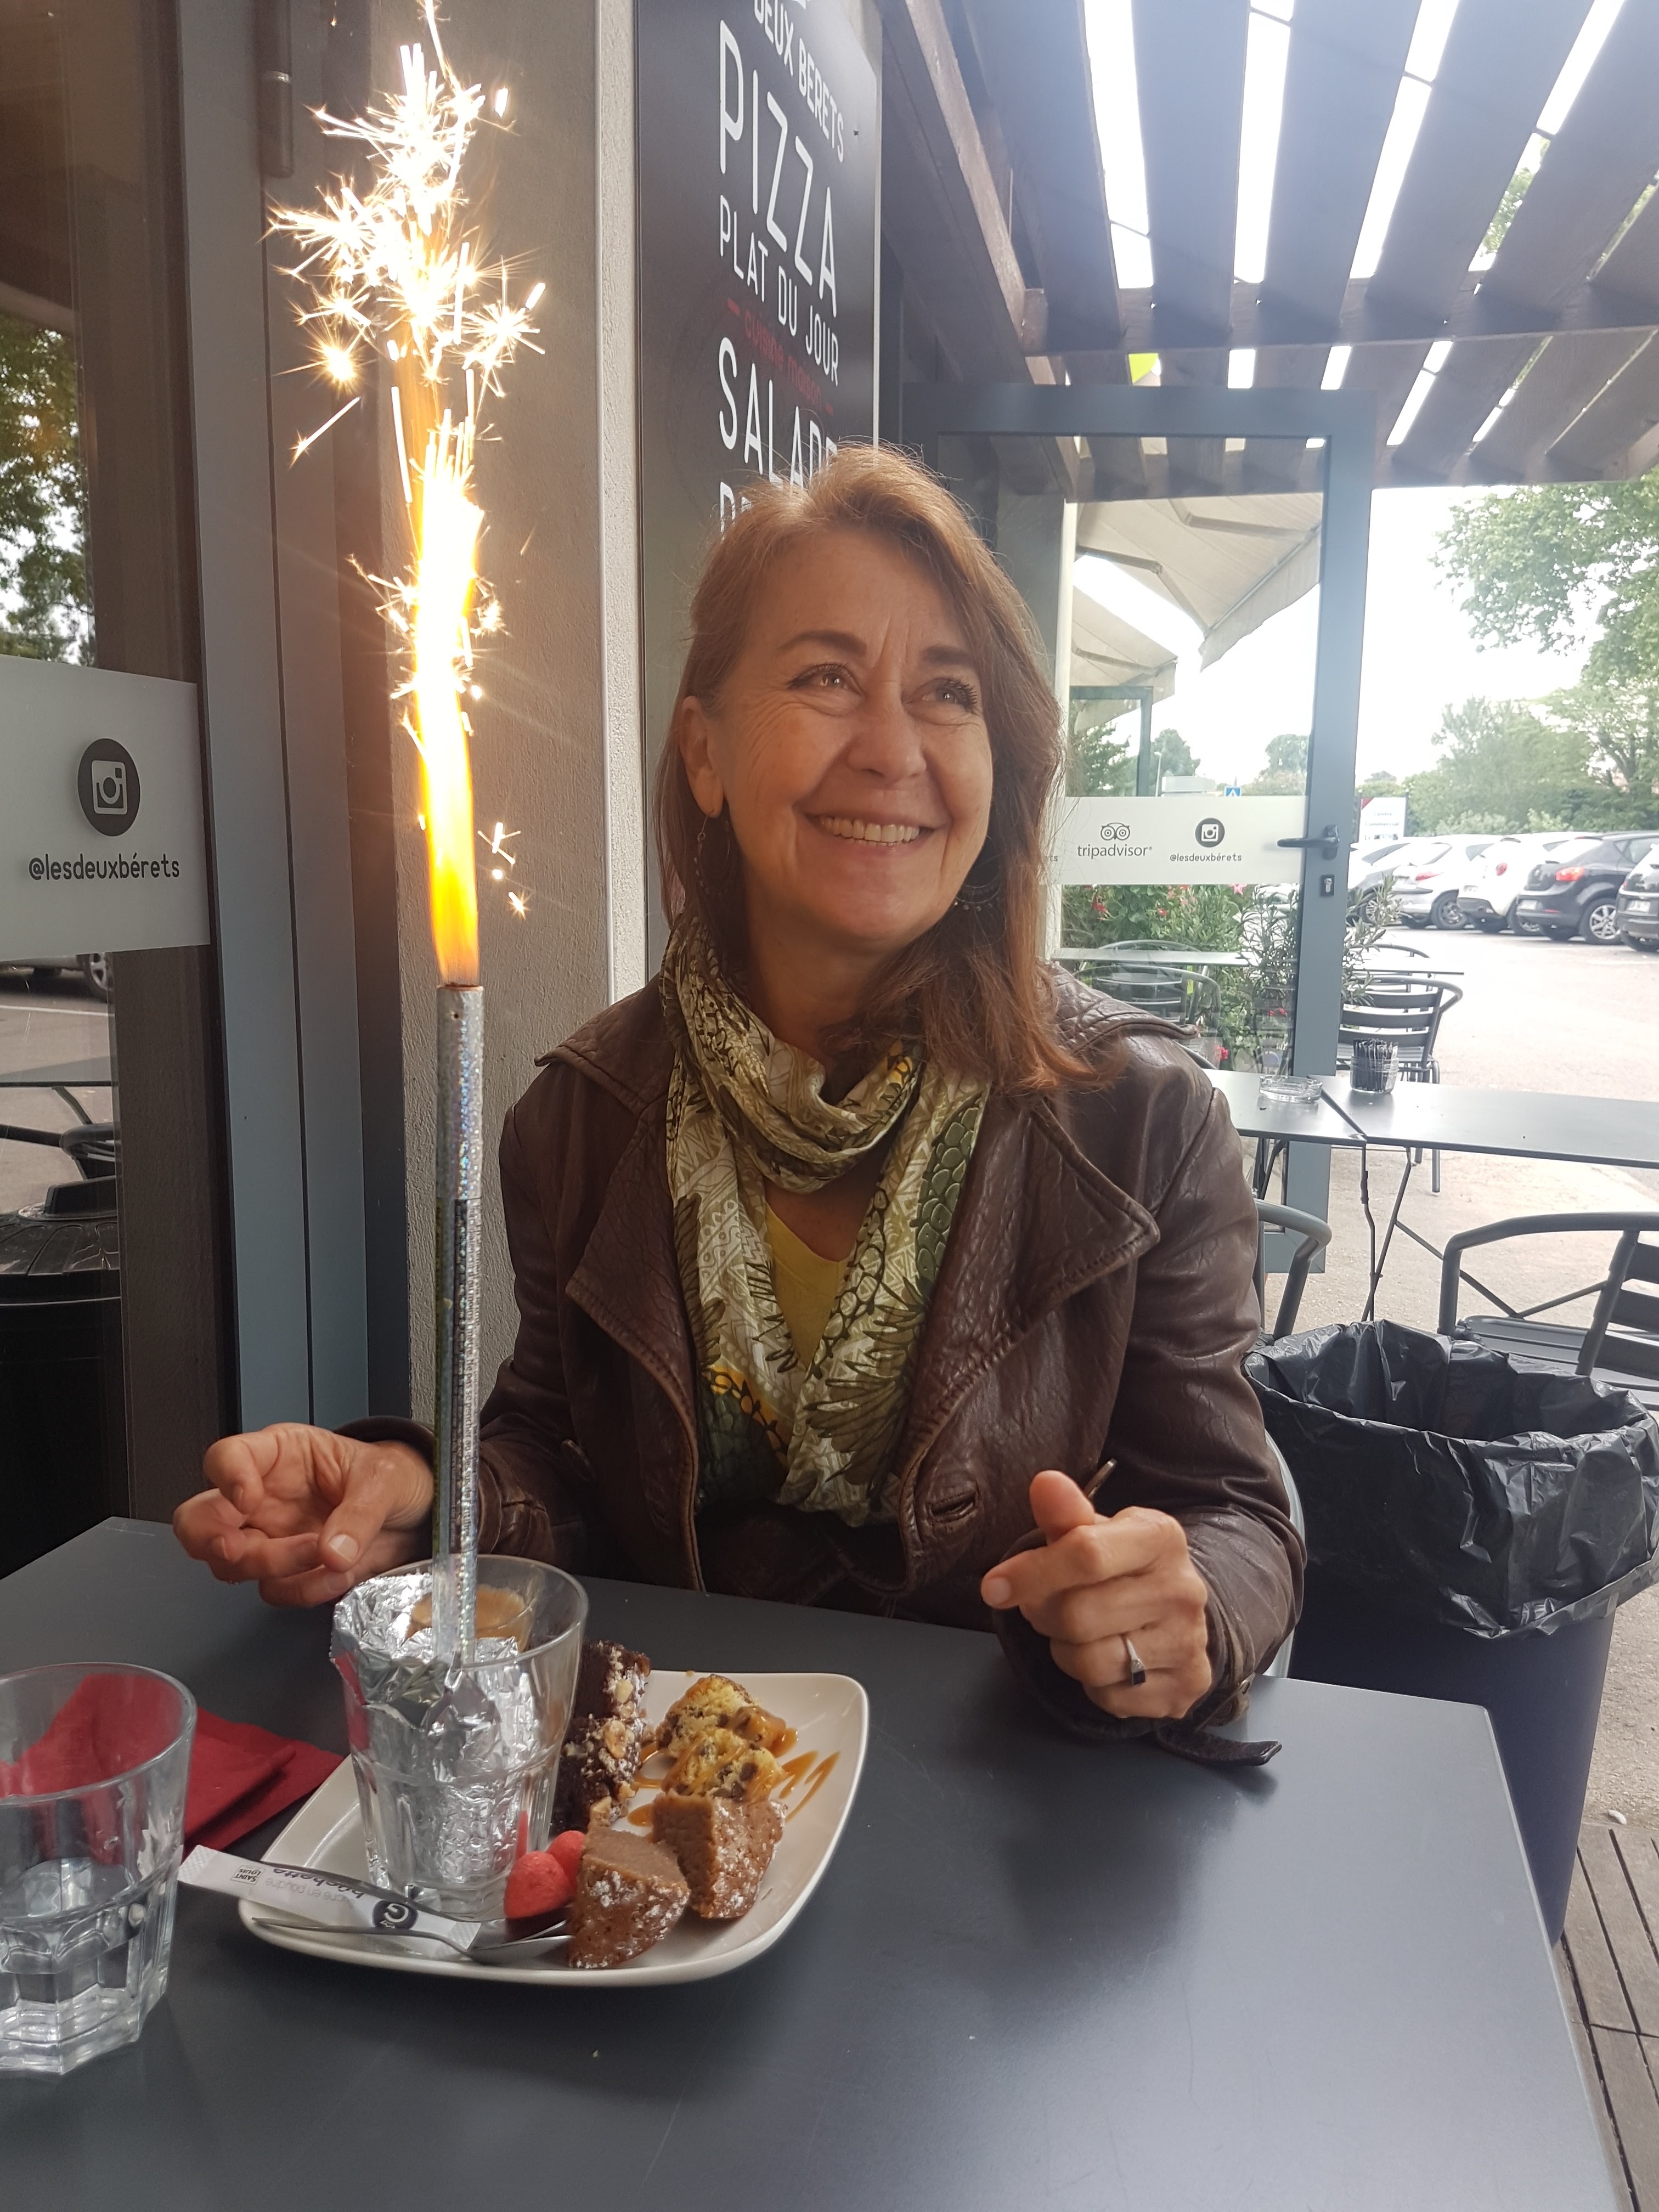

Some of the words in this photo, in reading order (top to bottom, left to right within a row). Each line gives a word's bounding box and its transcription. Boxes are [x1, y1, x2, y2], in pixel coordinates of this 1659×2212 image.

[799, 38, 844, 162] BERETS
[720, 20, 837, 318] PIZZA
[720, 194, 769, 303] PLAT
[778, 265, 797, 337] DU
[805, 304, 839, 387] JOUR
[29, 853, 180, 880] @lesdeuxbérets
[1169, 852, 1242, 862] @lesdeuxbérets
[234, 1873, 257, 1883] SAINT
